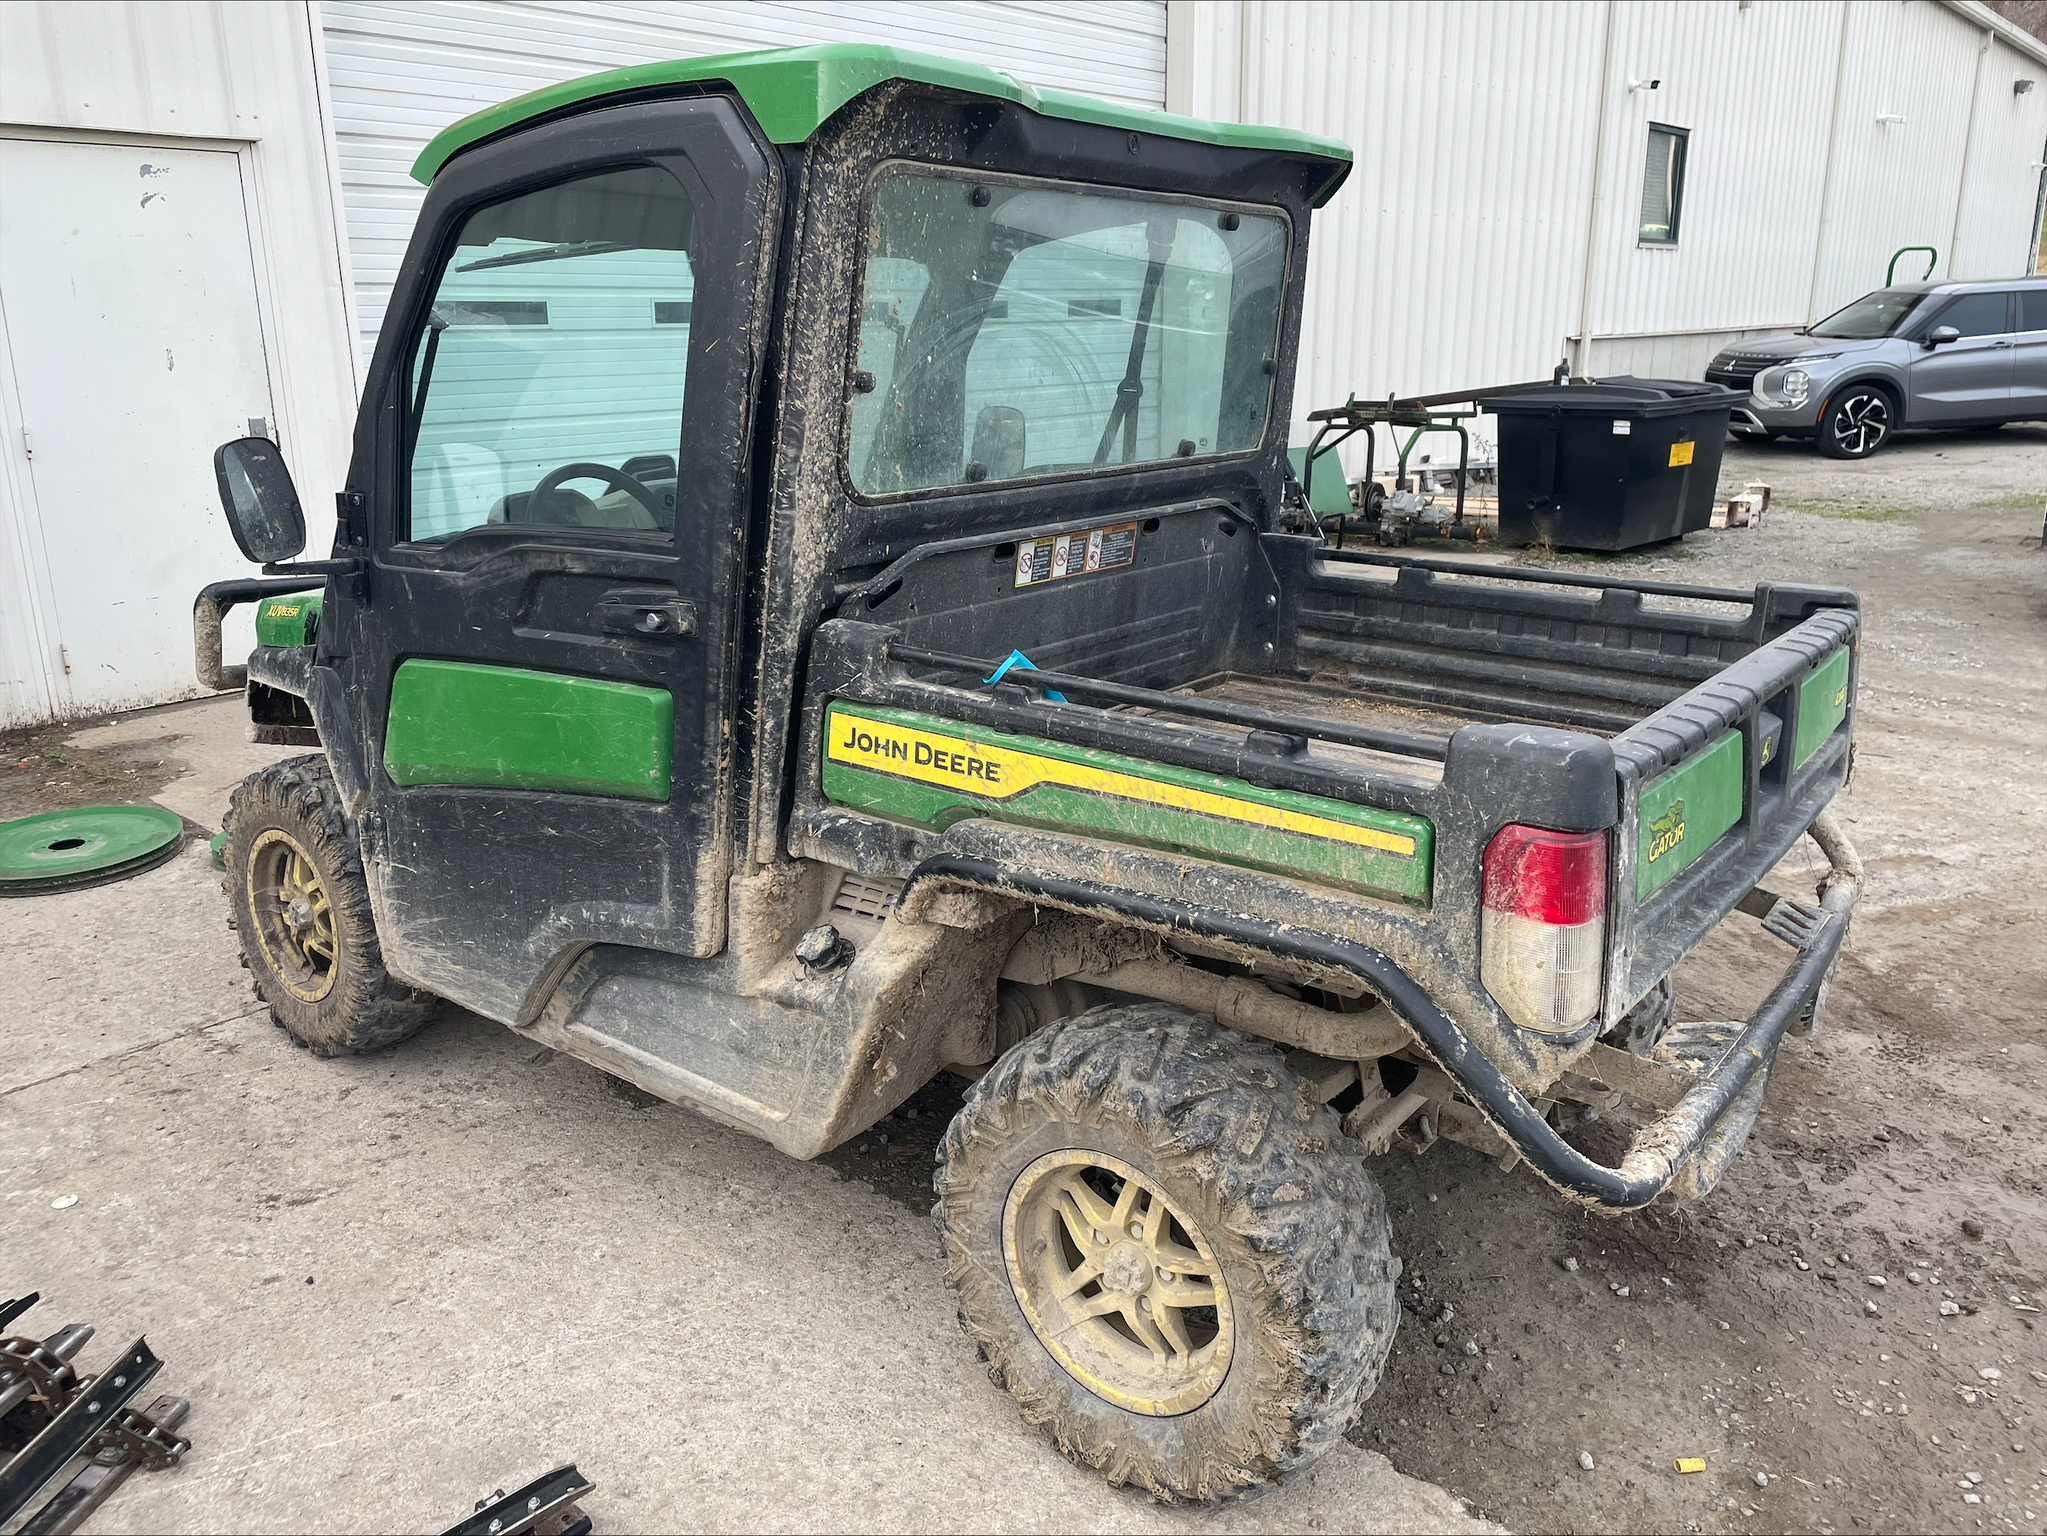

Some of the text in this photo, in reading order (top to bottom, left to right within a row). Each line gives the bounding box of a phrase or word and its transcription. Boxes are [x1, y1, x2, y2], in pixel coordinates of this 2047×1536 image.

[843, 727, 1002, 783] JOHN DEERE
[1648, 821, 1685, 864] GATOR
